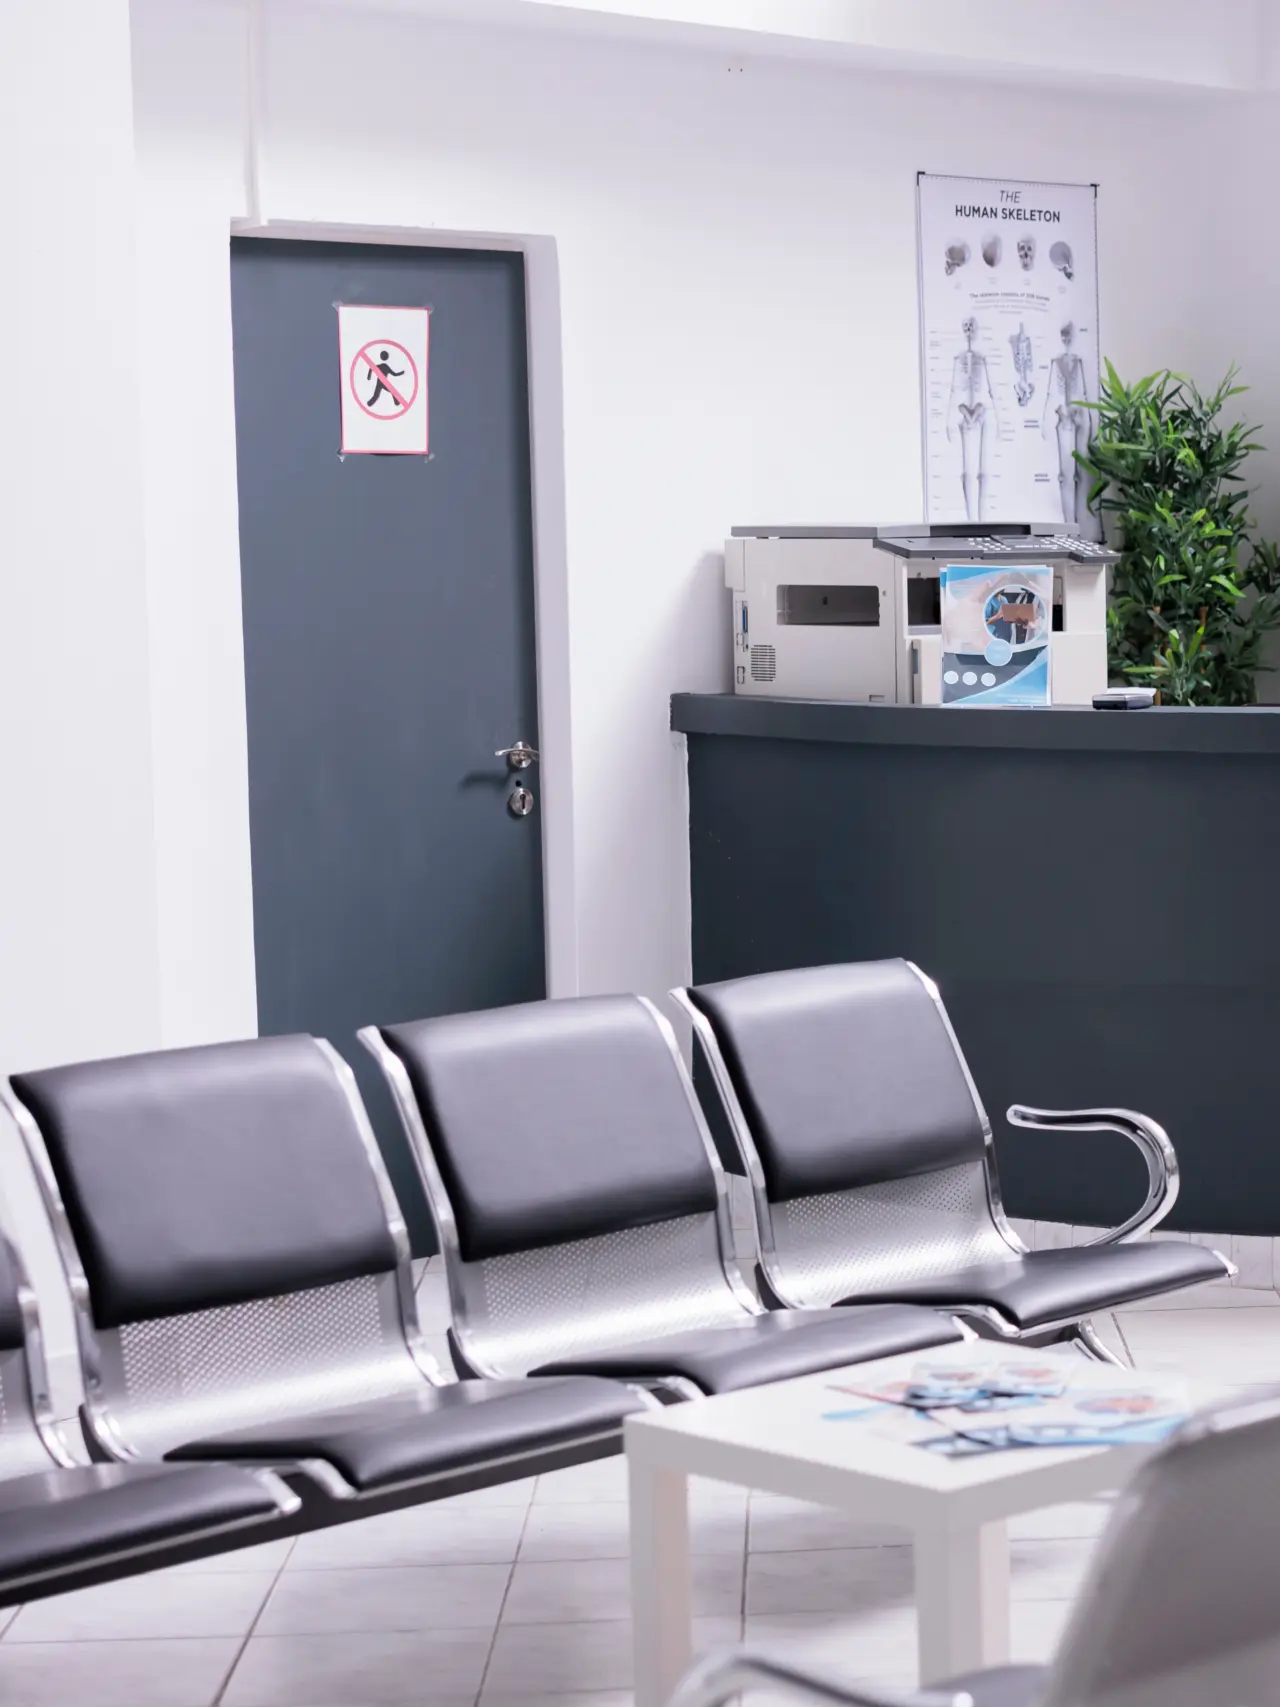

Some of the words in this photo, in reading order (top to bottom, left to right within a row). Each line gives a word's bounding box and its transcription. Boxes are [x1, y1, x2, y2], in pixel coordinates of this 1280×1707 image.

[999, 190, 1022, 204] THE
[955, 205, 998, 220] HUMAN
[1001, 207, 1060, 223] SKELETON
